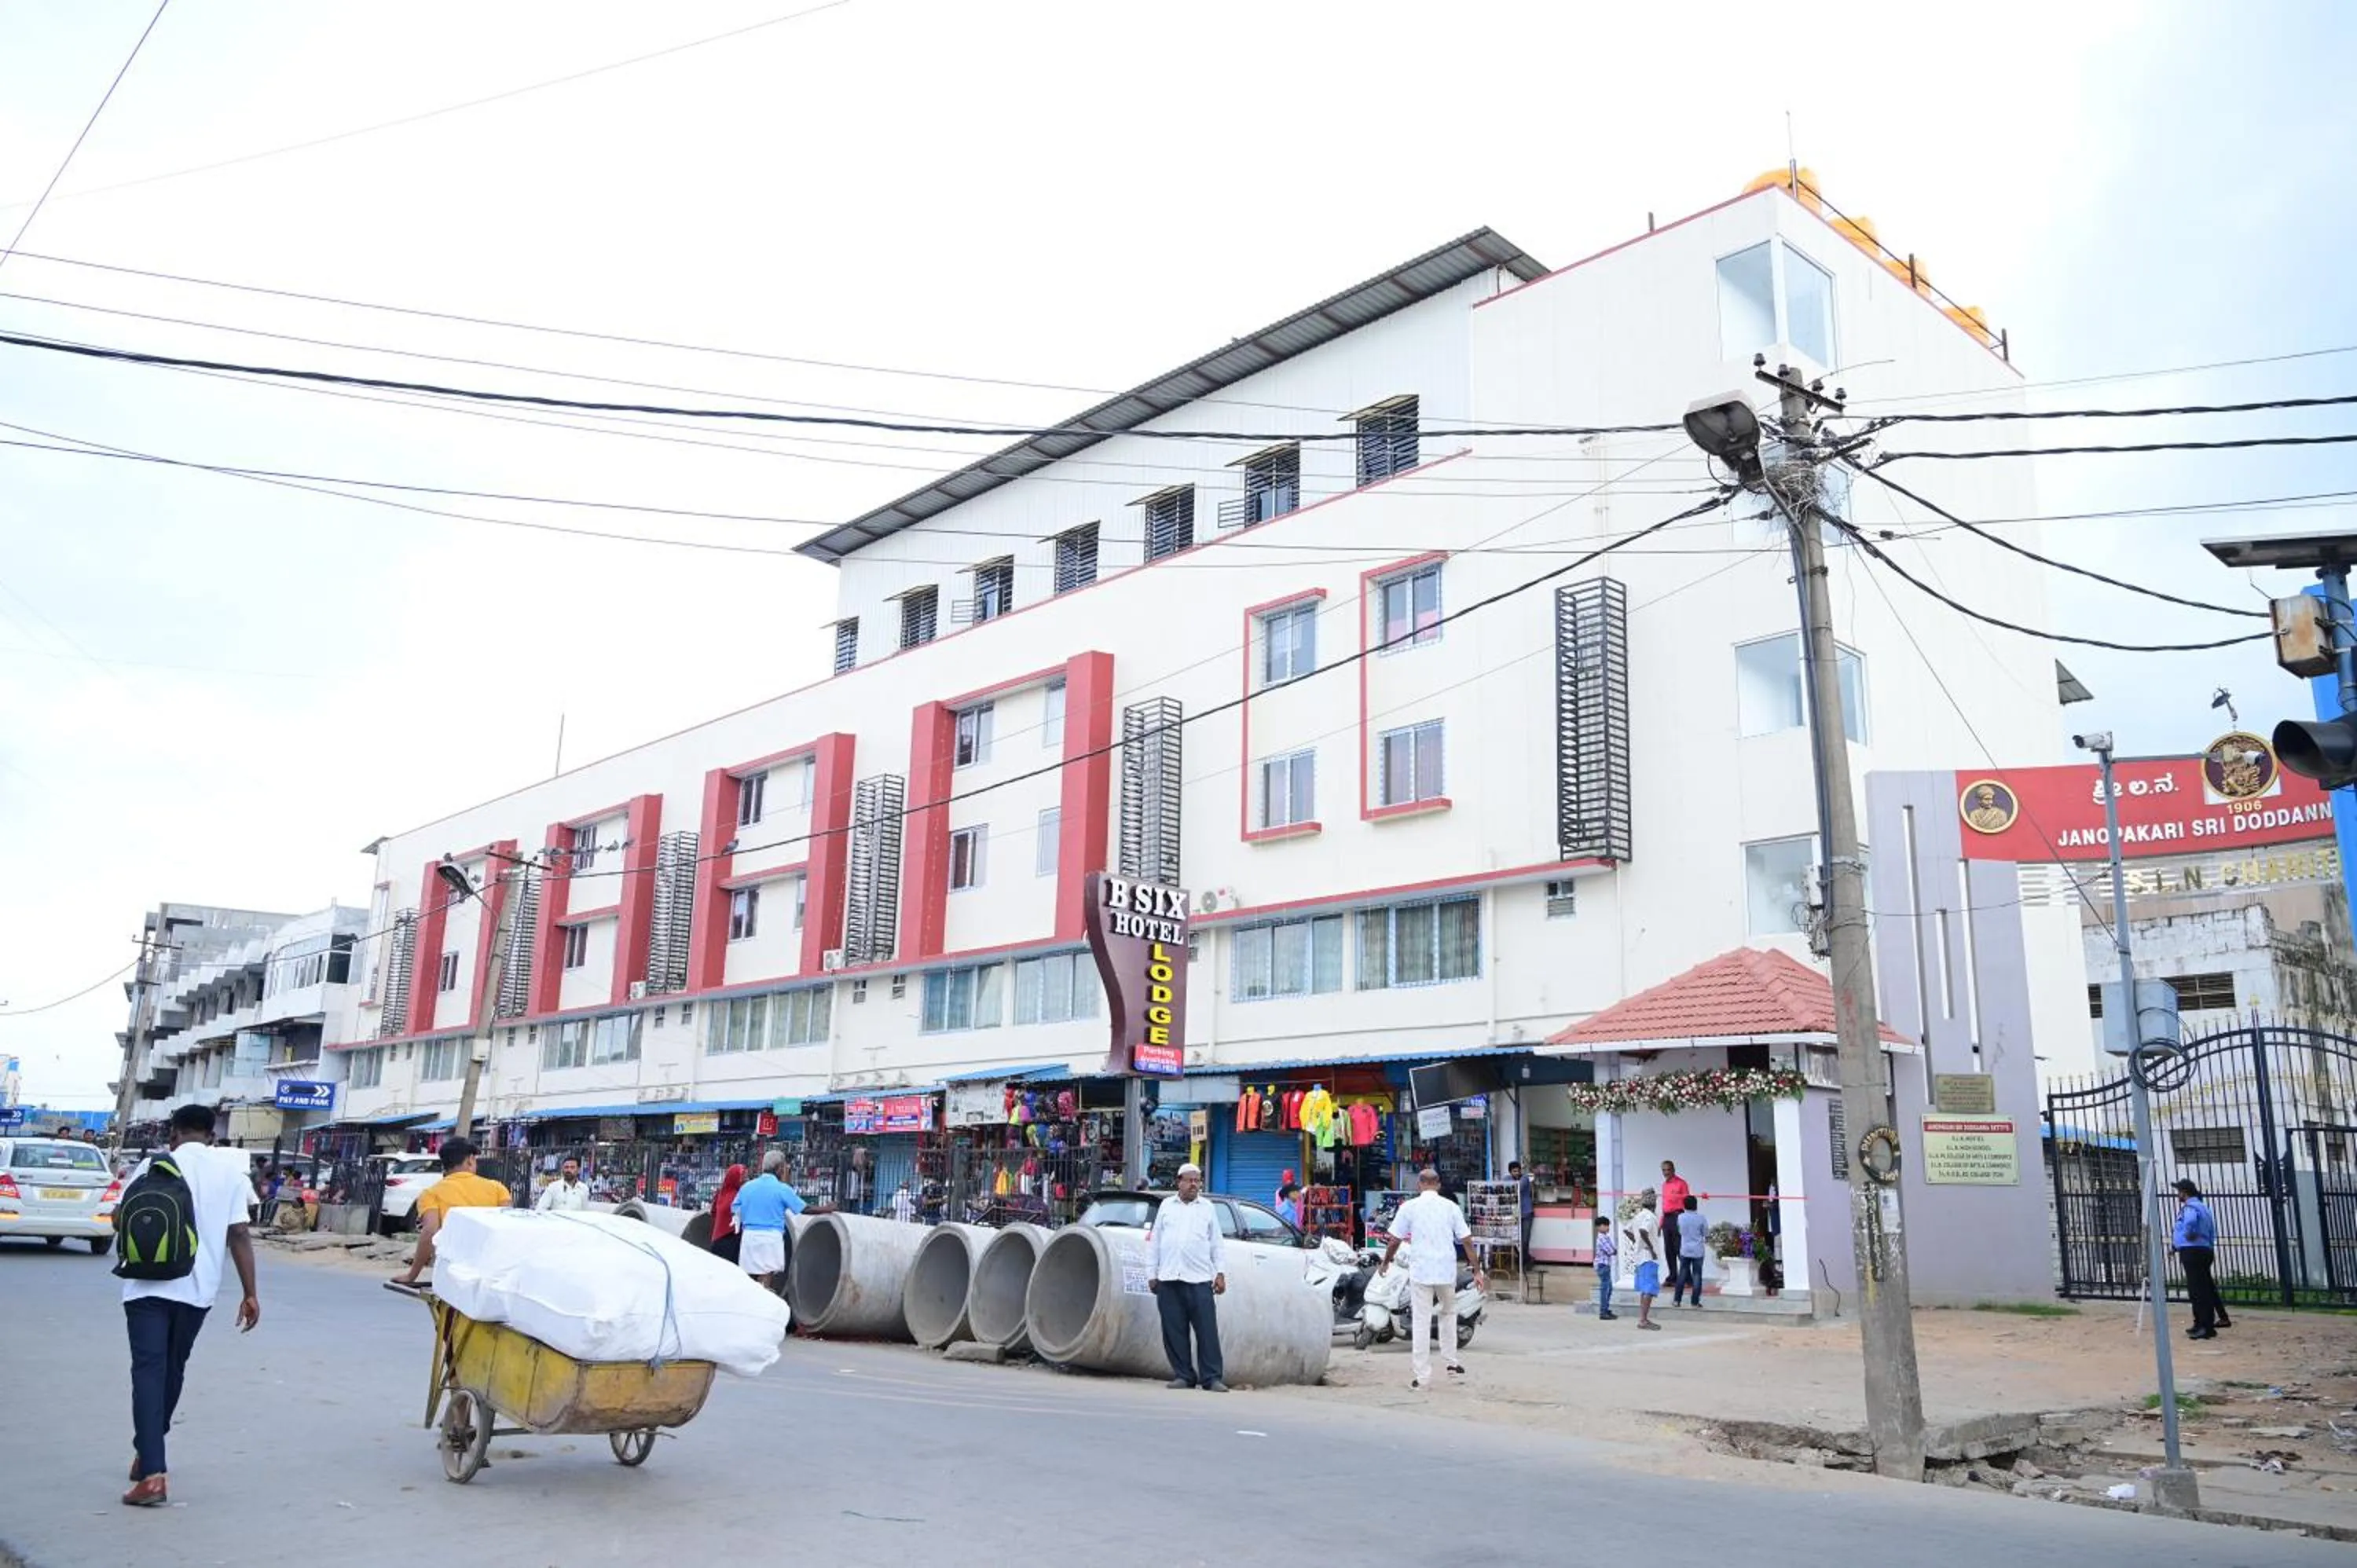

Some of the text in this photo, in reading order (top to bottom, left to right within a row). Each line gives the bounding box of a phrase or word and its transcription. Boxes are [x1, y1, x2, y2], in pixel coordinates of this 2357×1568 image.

[2227, 800, 2263, 815] 1906
[2191, 817, 2226, 837] SRI
[1109, 877, 1187, 920] B SIX
[1115, 911, 1184, 945] HOTEL
[1149, 943, 1173, 1046] LODGE
[294, 1097, 310, 1105] AND
[310, 1097, 329, 1107] PARK
